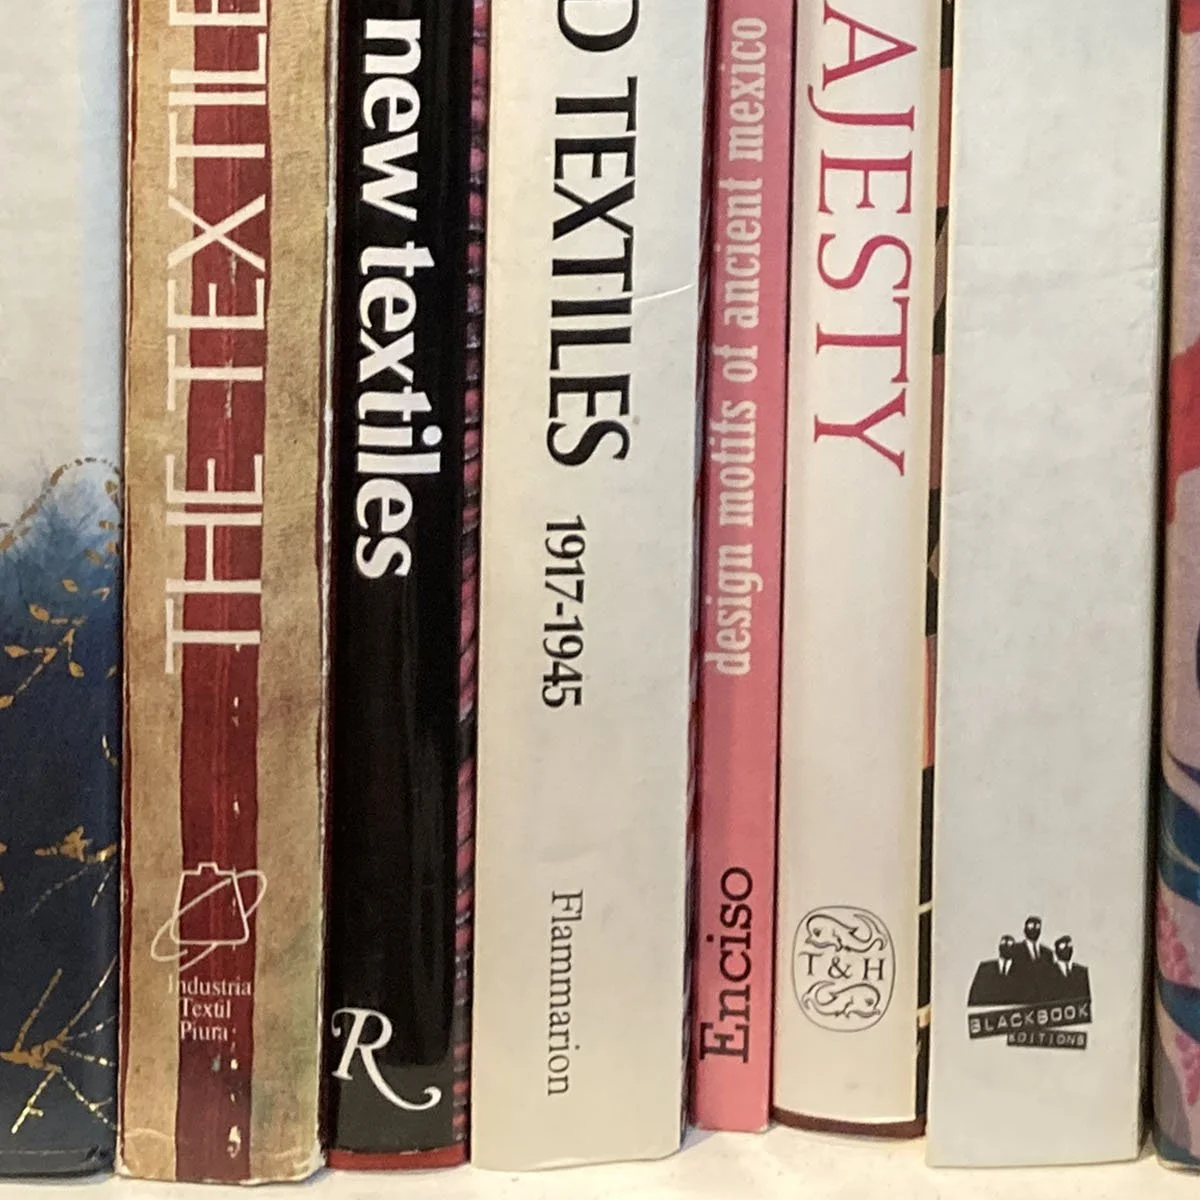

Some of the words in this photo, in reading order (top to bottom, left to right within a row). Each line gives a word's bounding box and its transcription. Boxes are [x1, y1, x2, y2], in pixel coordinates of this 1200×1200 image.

[361, 19, 422, 221] new
[719, 17, 768, 162] mexico
[545, 76, 638, 467] TEXTILES
[715, 178, 763, 329] ancient
[356, 242, 441, 579] textiles
[713, 345, 758, 383] of
[709, 400, 757, 527] motifs
[164, 454, 263, 674] THE
[541, 514, 588, 708] 1917-1945
[705, 544, 763, 675] design
[168, 974, 251, 997] Industria
[180, 998, 231, 1019] Textil
[547, 889, 584, 1097] Flammarion
[700, 866, 753, 1064] Enciso
[800, 952, 818, 978] T
[828, 957, 854, 980] &
[862, 957, 886, 980] H
[970, 1003, 1090, 1035] BLACKBOOK
[180, 1020, 228, 1042] Piura
[331, 1007, 442, 1110] R
[1008, 1031, 1087, 1048] EDITIONS
